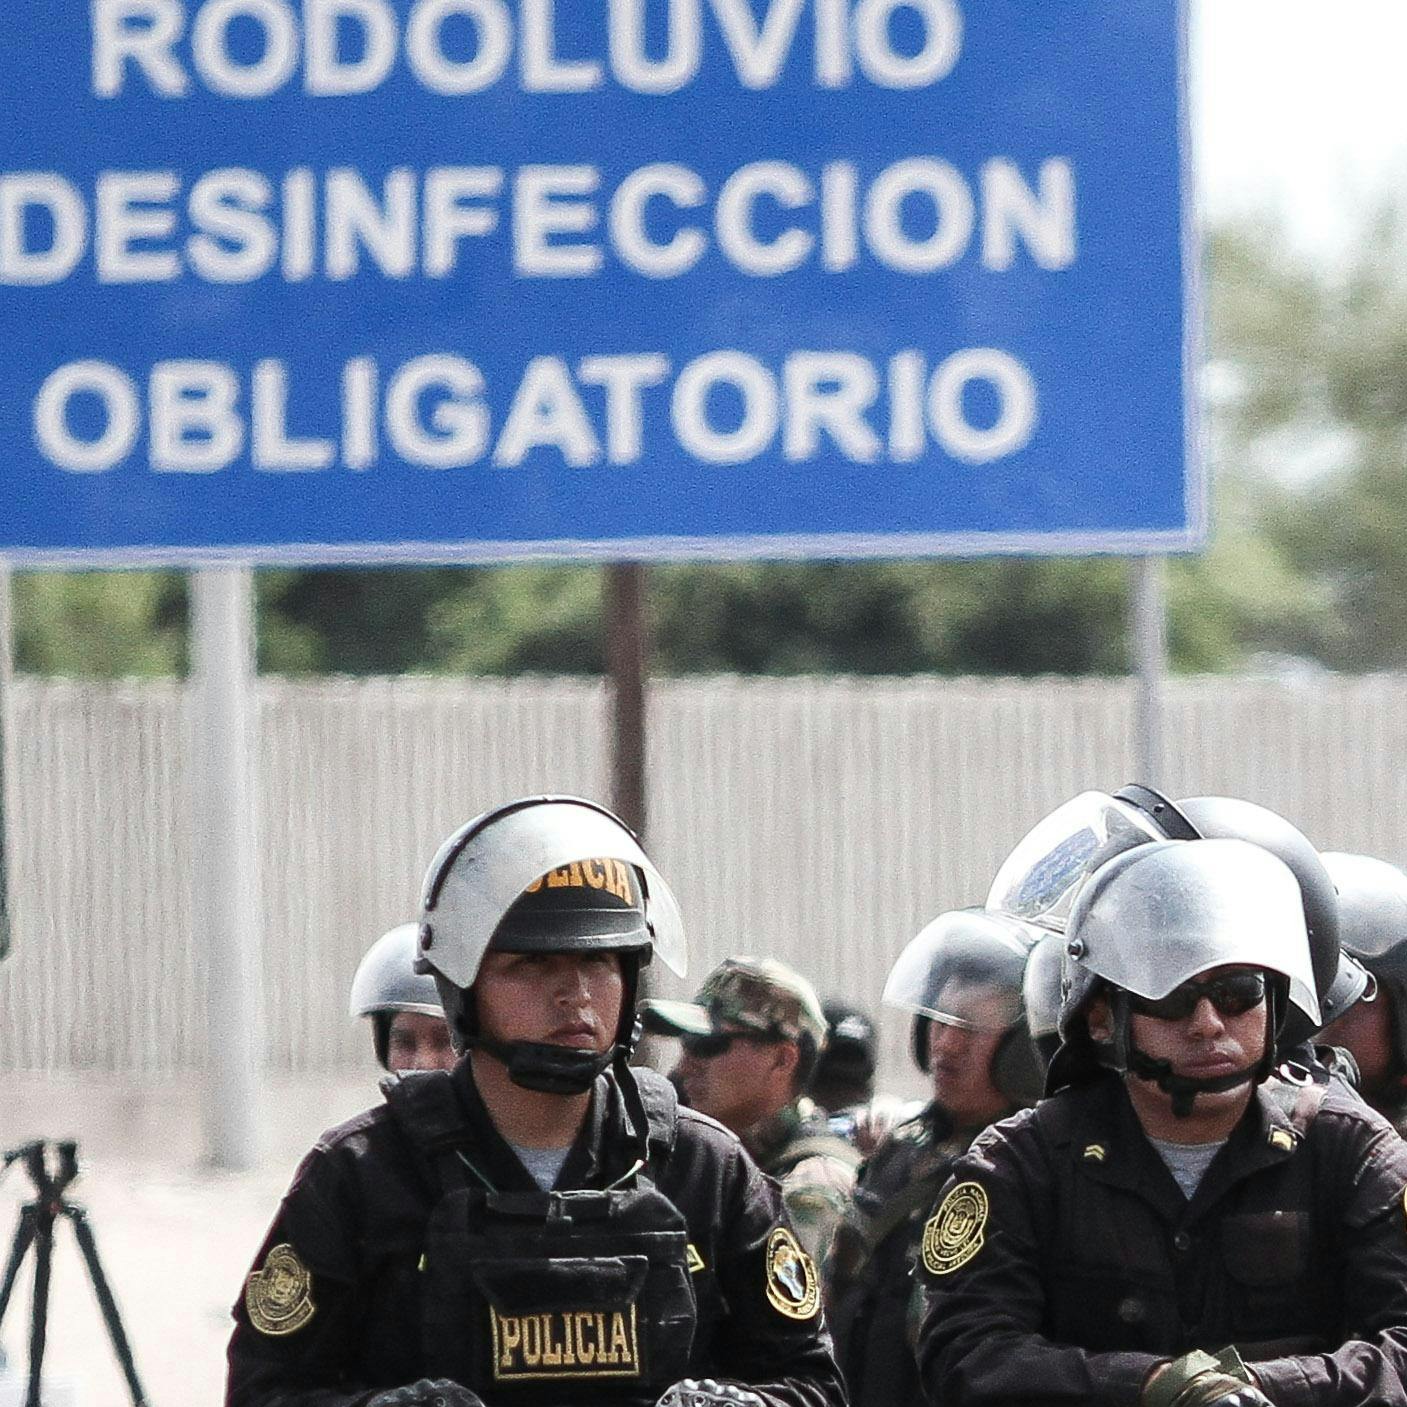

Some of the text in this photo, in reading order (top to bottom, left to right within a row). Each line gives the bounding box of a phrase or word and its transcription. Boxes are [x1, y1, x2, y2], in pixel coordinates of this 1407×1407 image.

[91, 0, 965, 98] RODOLUVIO
[0, 155, 1077, 285] DESINFECCION
[33, 346, 1037, 473] OBLIGATORIO
[501, 1313, 633, 1366] POLICIA
